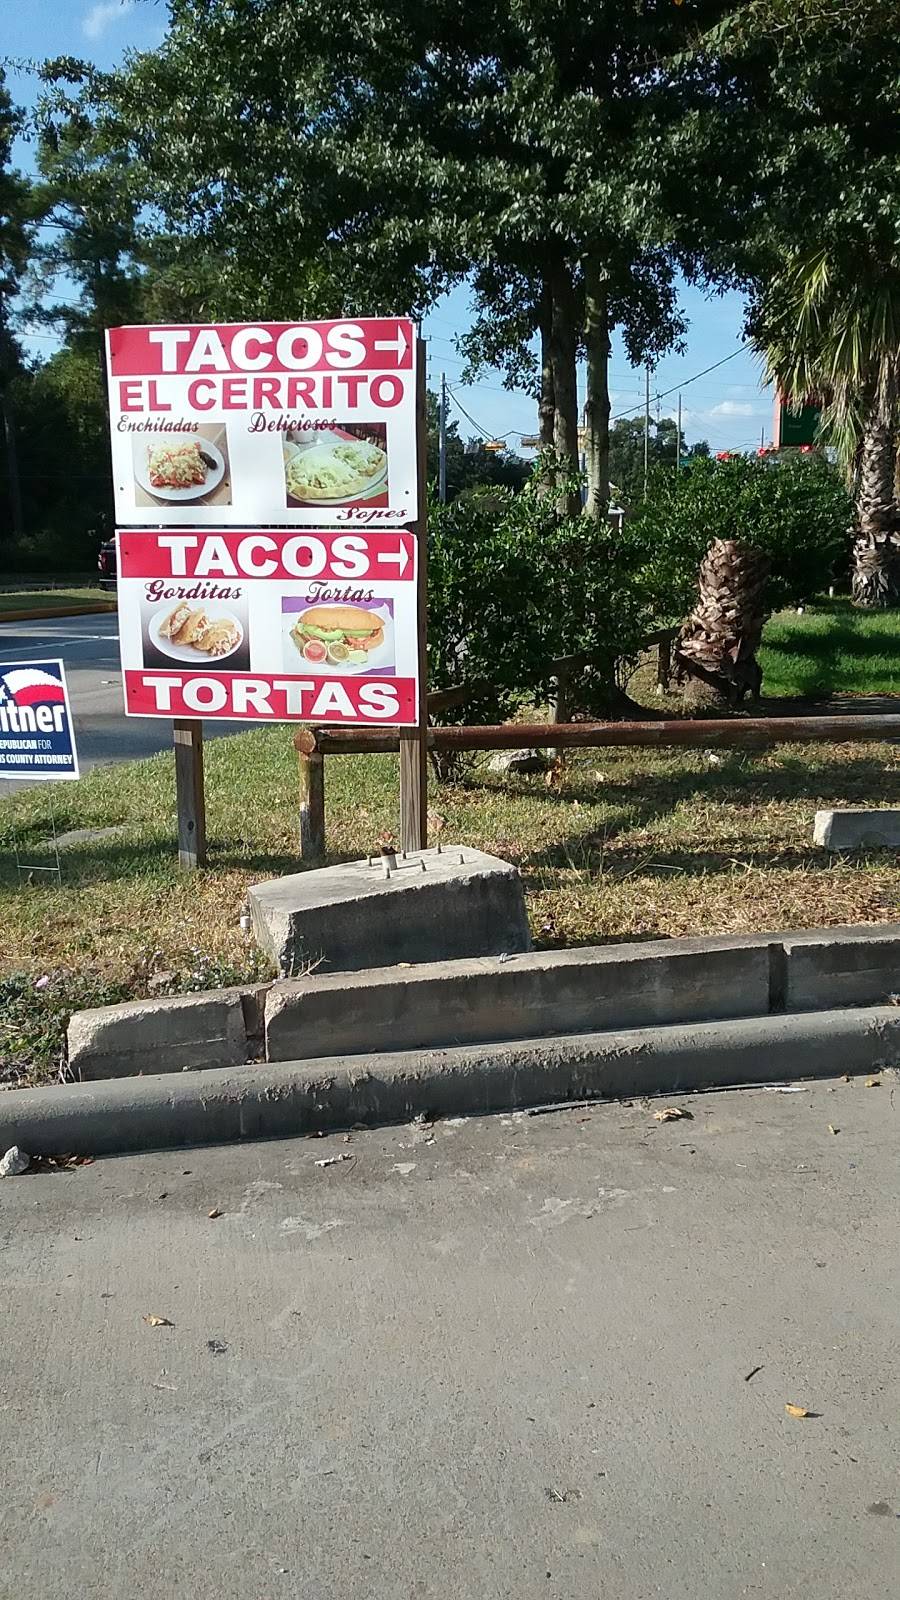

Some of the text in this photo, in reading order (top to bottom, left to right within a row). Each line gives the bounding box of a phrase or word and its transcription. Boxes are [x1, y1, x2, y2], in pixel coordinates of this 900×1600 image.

[149, 323, 367, 372] TACOS
[119, 375, 405, 412] EL CERRITO
[117, 415, 200, 433] Enchiladas
[248, 411, 338, 434] Deliciosos
[337, 507, 408, 523] Sopes
[158, 535, 370, 578] TACOS
[145, 580, 242, 602] Gorditas
[306, 581, 375, 603] Tortas
[142, 676, 400, 718] TORTAS
[0, 699, 65, 733] itner
[38, 739, 52, 750] FOR
[6, 754, 33, 764] COUNTY
[34, 754, 73, 764] ATTORNEY
